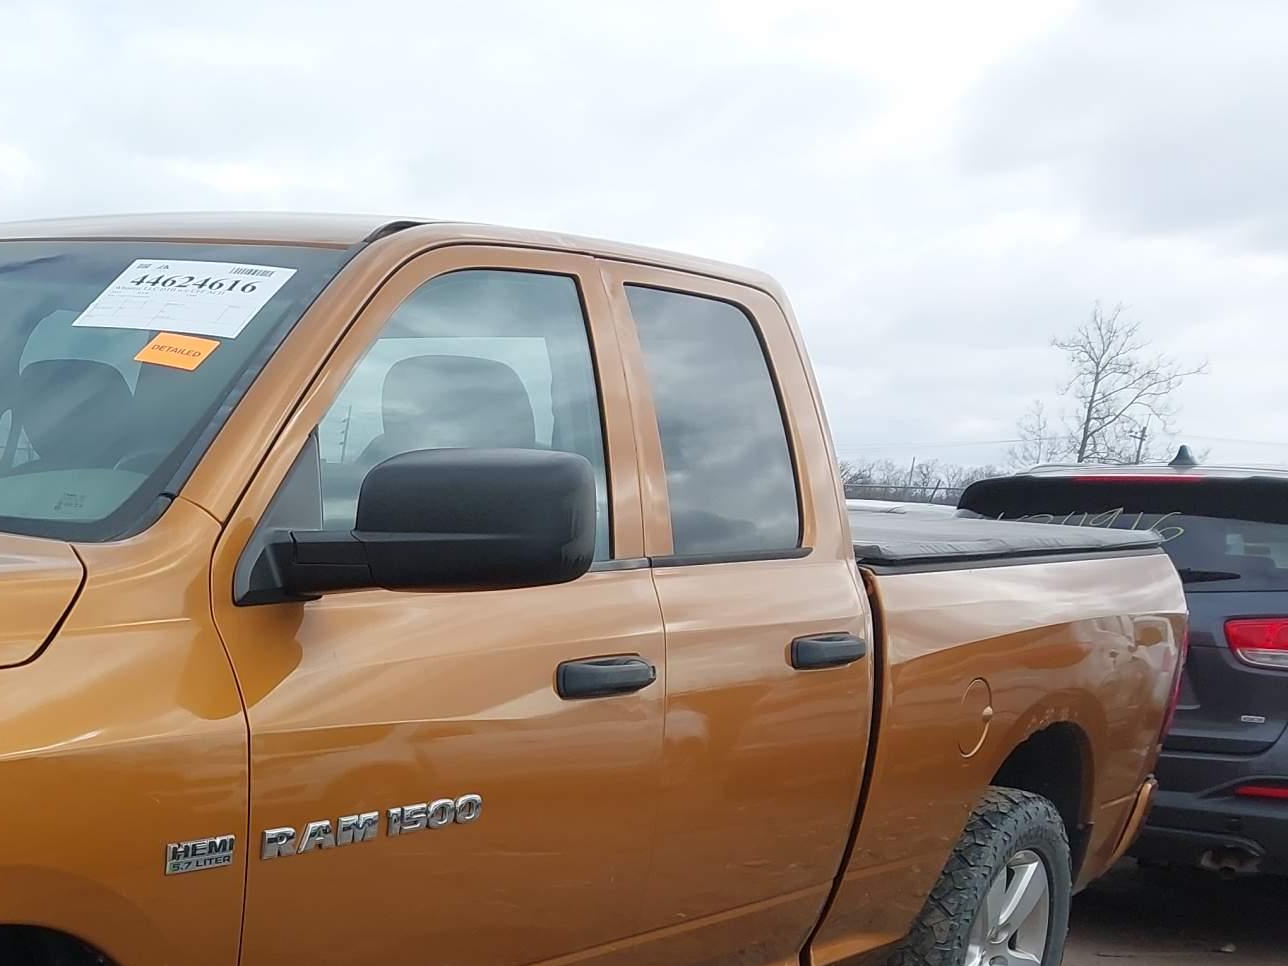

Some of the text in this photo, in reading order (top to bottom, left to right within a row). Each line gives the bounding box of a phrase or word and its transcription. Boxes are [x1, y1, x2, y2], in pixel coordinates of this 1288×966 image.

[130, 274, 261, 294] 44624616
[152, 344, 201, 357] DETAILED
[261, 794, 482, 860] RAM 1500
[169, 836, 235, 861] HEMI
[171, 855, 231, 872] 5.7 LITER
